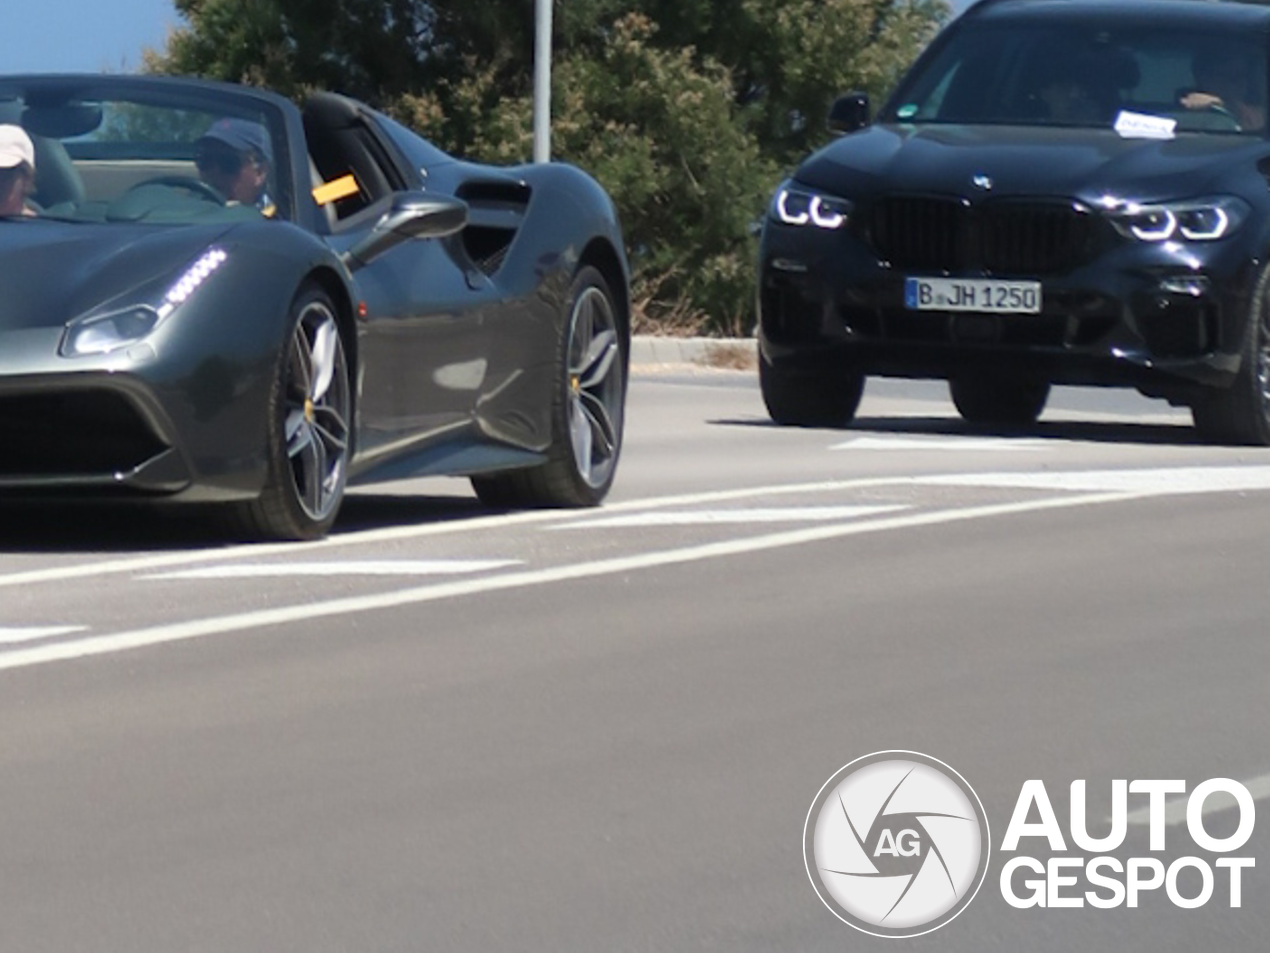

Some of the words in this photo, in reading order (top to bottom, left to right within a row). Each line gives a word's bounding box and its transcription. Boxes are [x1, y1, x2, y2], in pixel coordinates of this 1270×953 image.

[918, 283, 932, 305] B
[947, 284, 975, 306] JH
[981, 287, 1036, 309] 1250
